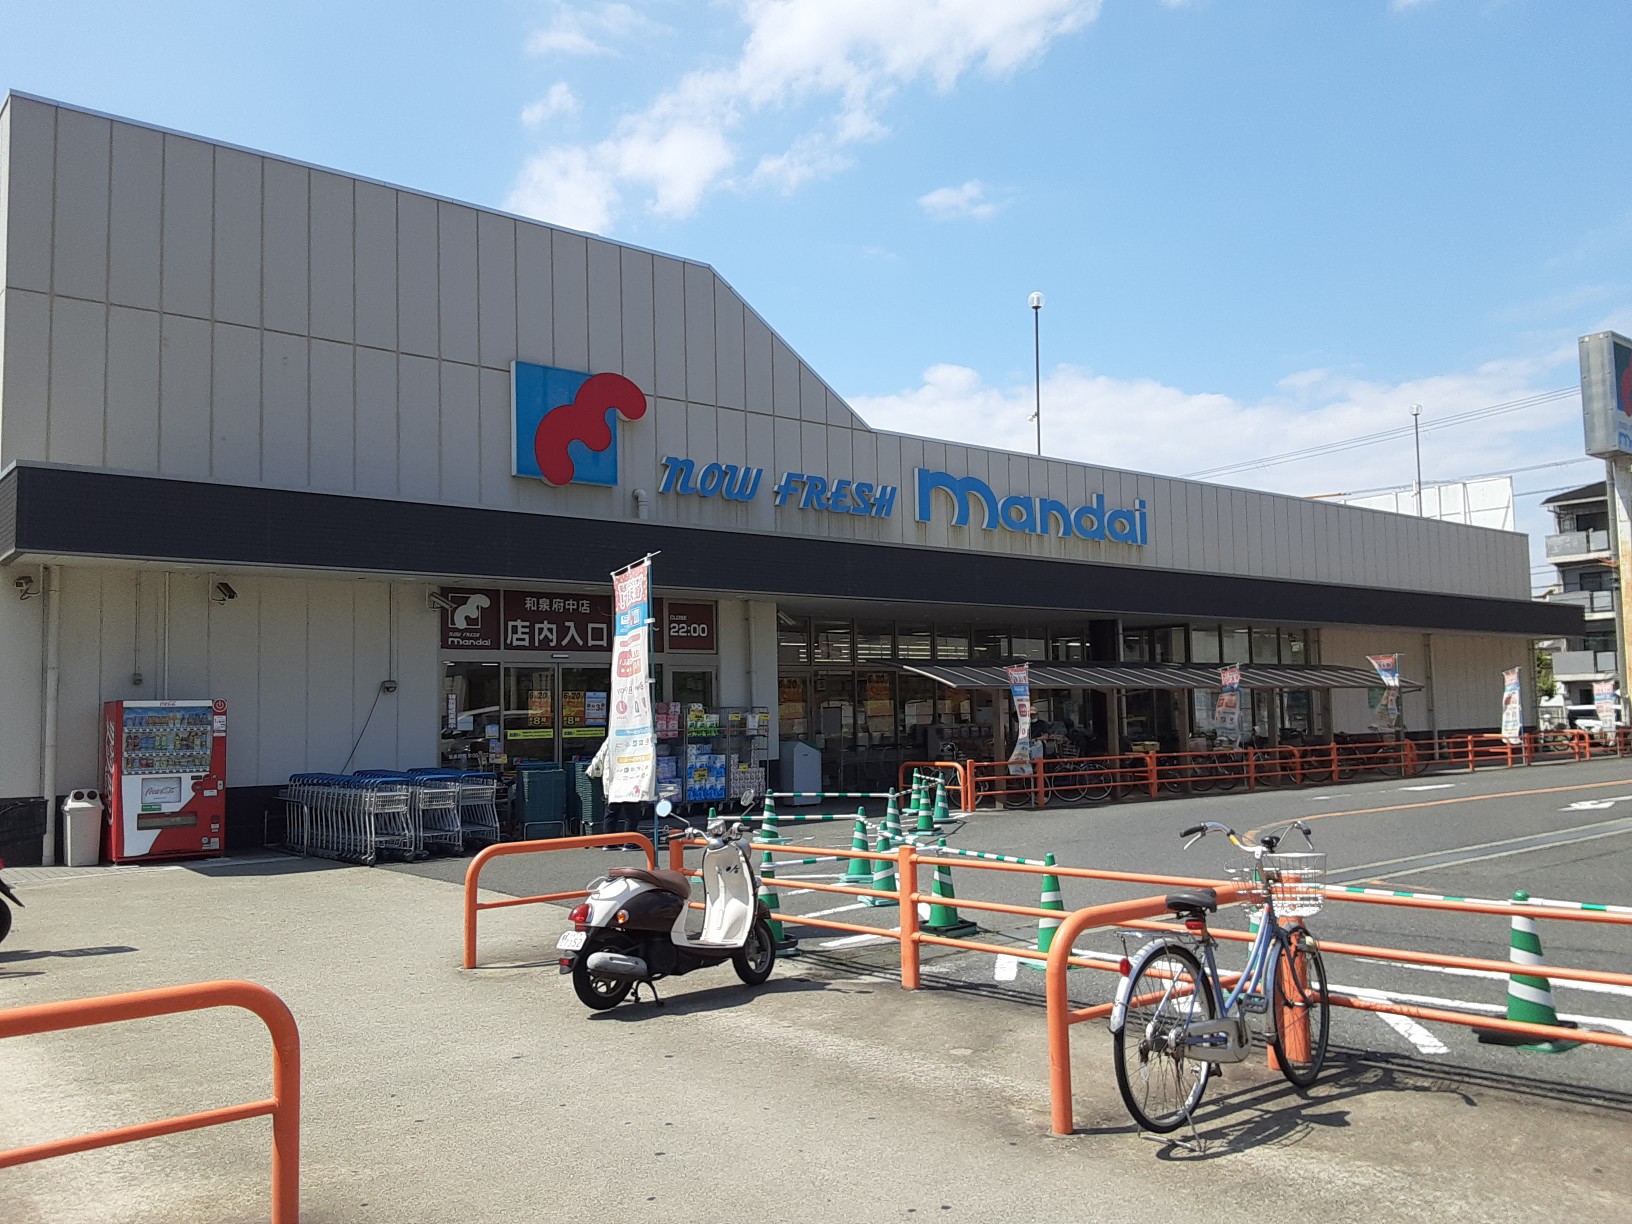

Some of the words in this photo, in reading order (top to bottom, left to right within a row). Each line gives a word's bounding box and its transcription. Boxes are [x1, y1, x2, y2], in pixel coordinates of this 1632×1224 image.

[773, 472, 897, 518] FRESH
[914, 467, 1148, 546] mandai
[525, 597, 591, 614] 和泉府中店
[506, 618, 608, 647] 店内入口
[670, 623, 708, 637] 22:00
[448, 637, 491, 646] mandai
